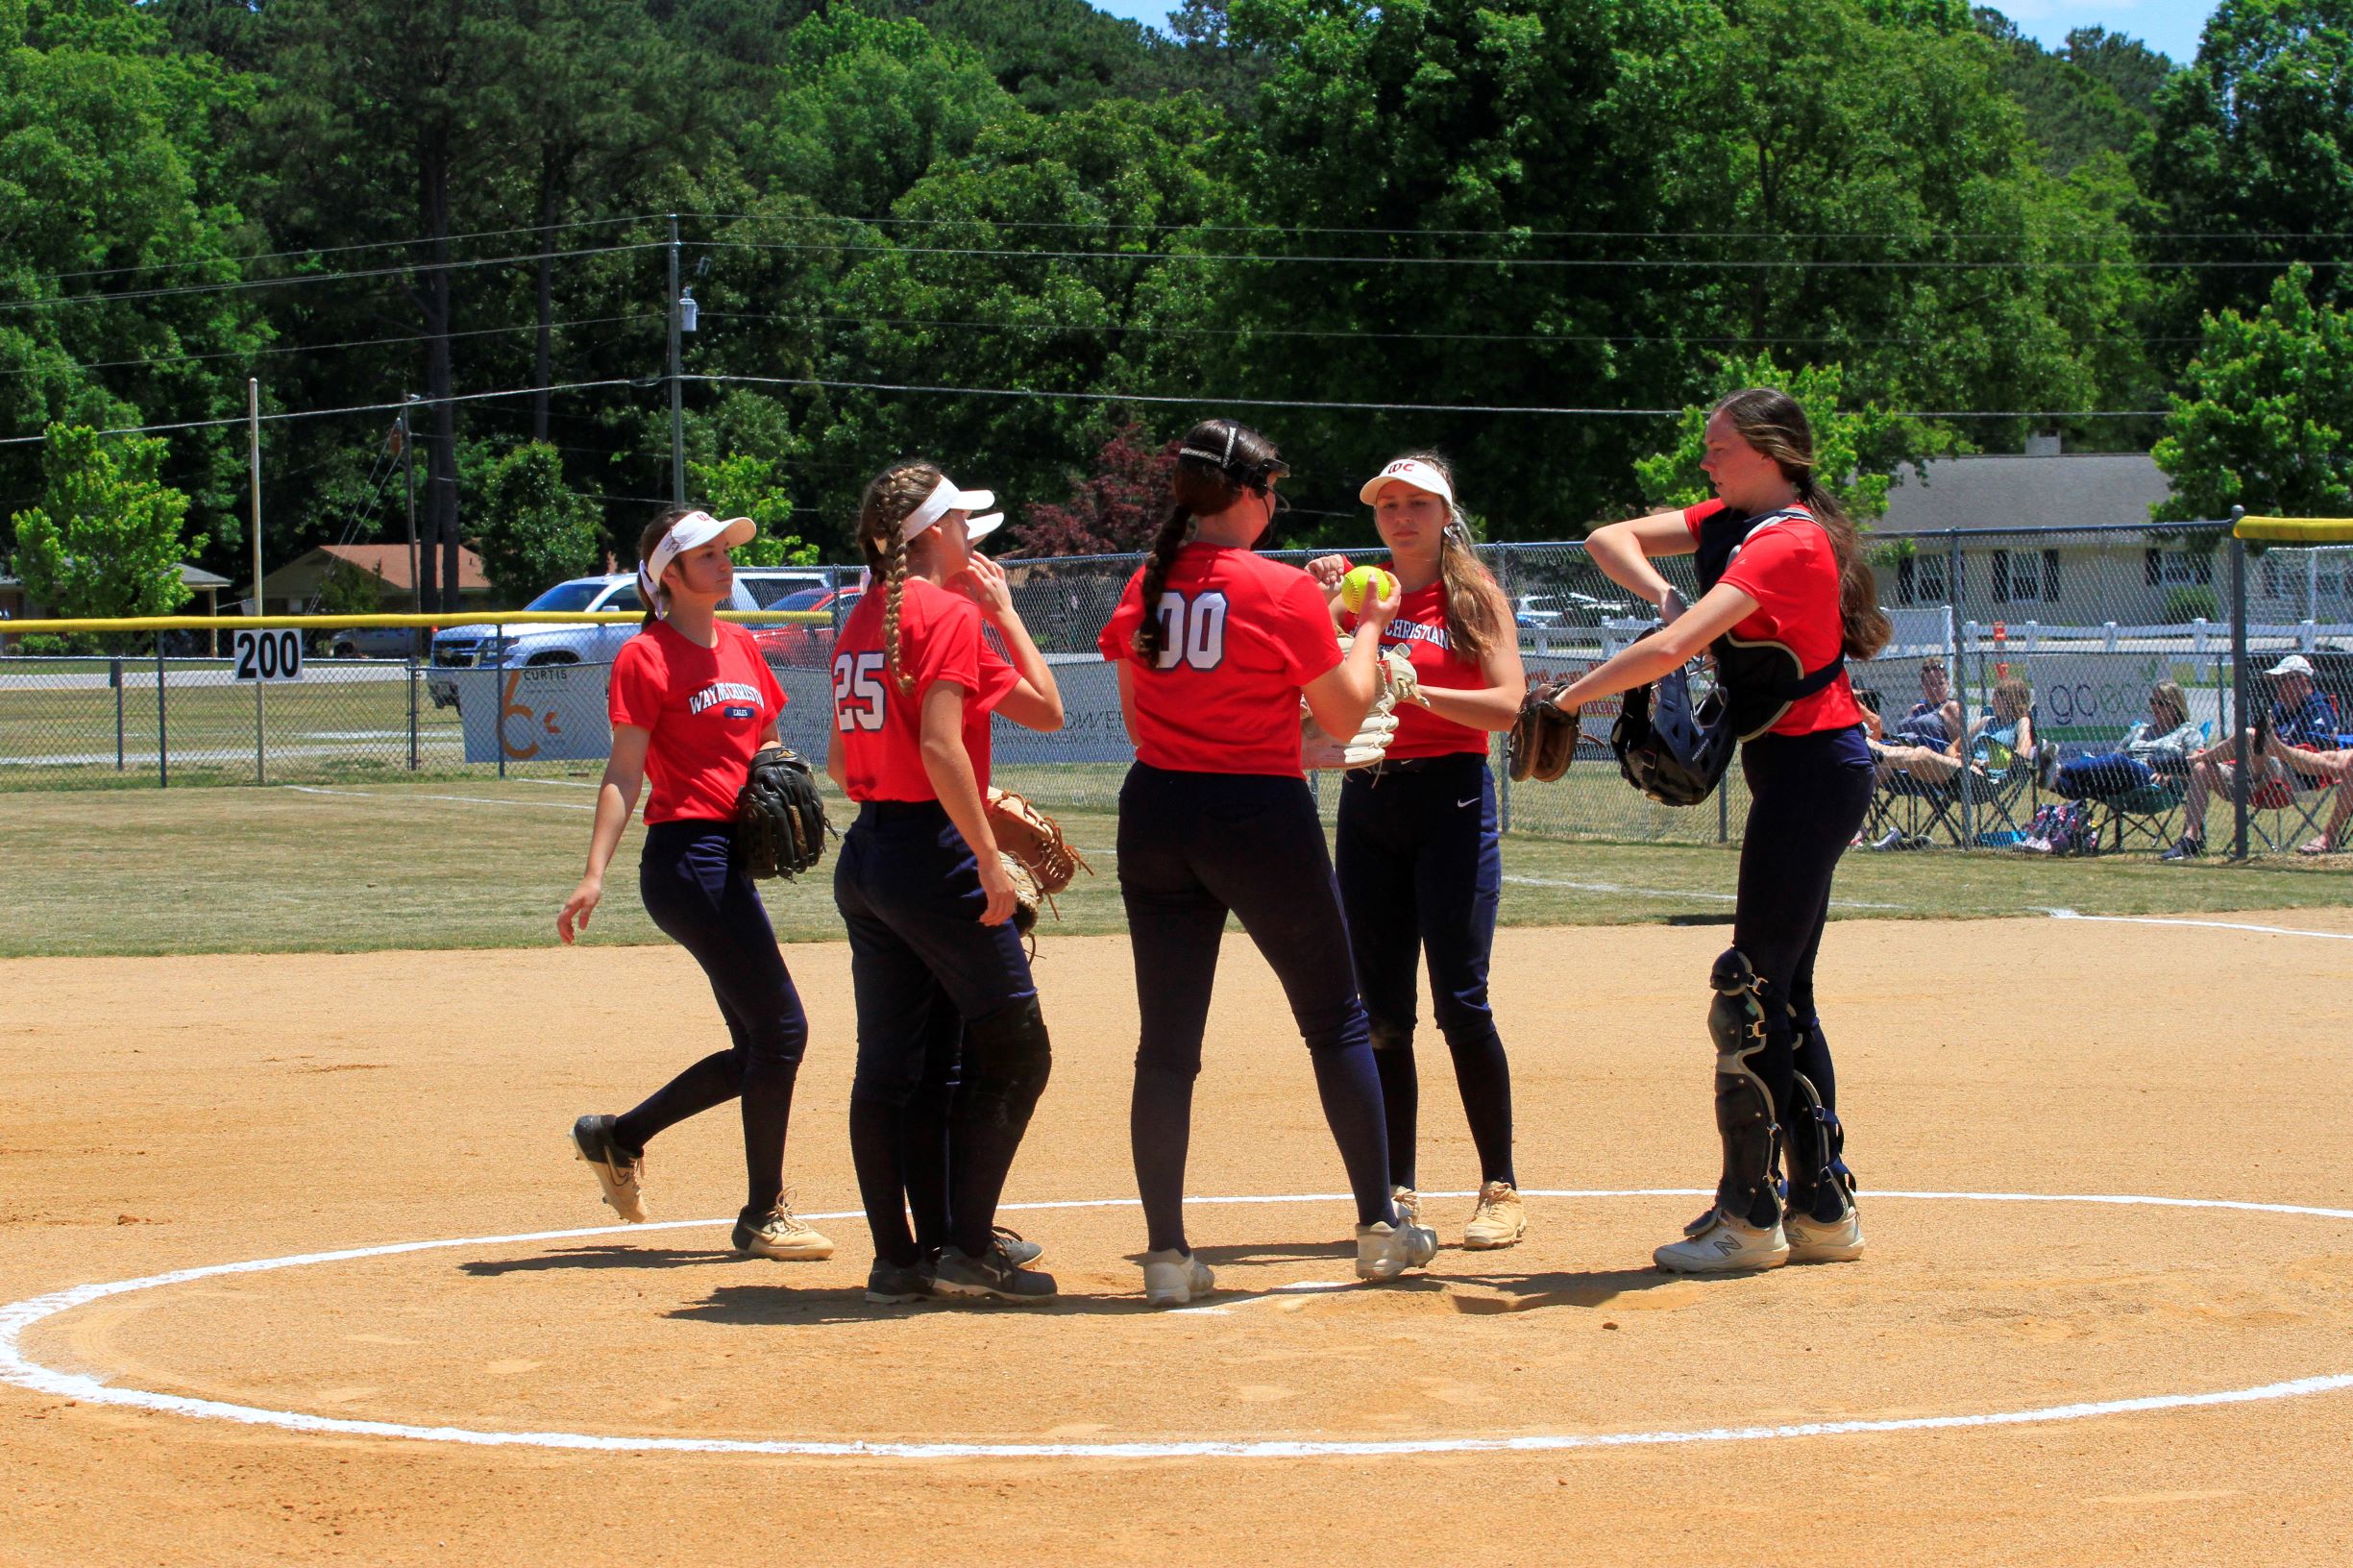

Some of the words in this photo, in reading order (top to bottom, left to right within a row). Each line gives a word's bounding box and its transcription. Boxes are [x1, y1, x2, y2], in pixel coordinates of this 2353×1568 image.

[1387, 463, 1415, 475] WC
[1155, 590, 1229, 672] 00
[1385, 619, 1449, 650] CHRISTIAN
[237, 631, 299, 678] 200
[523, 670, 568, 680] CURTIS
[834, 651, 886, 732] 25
